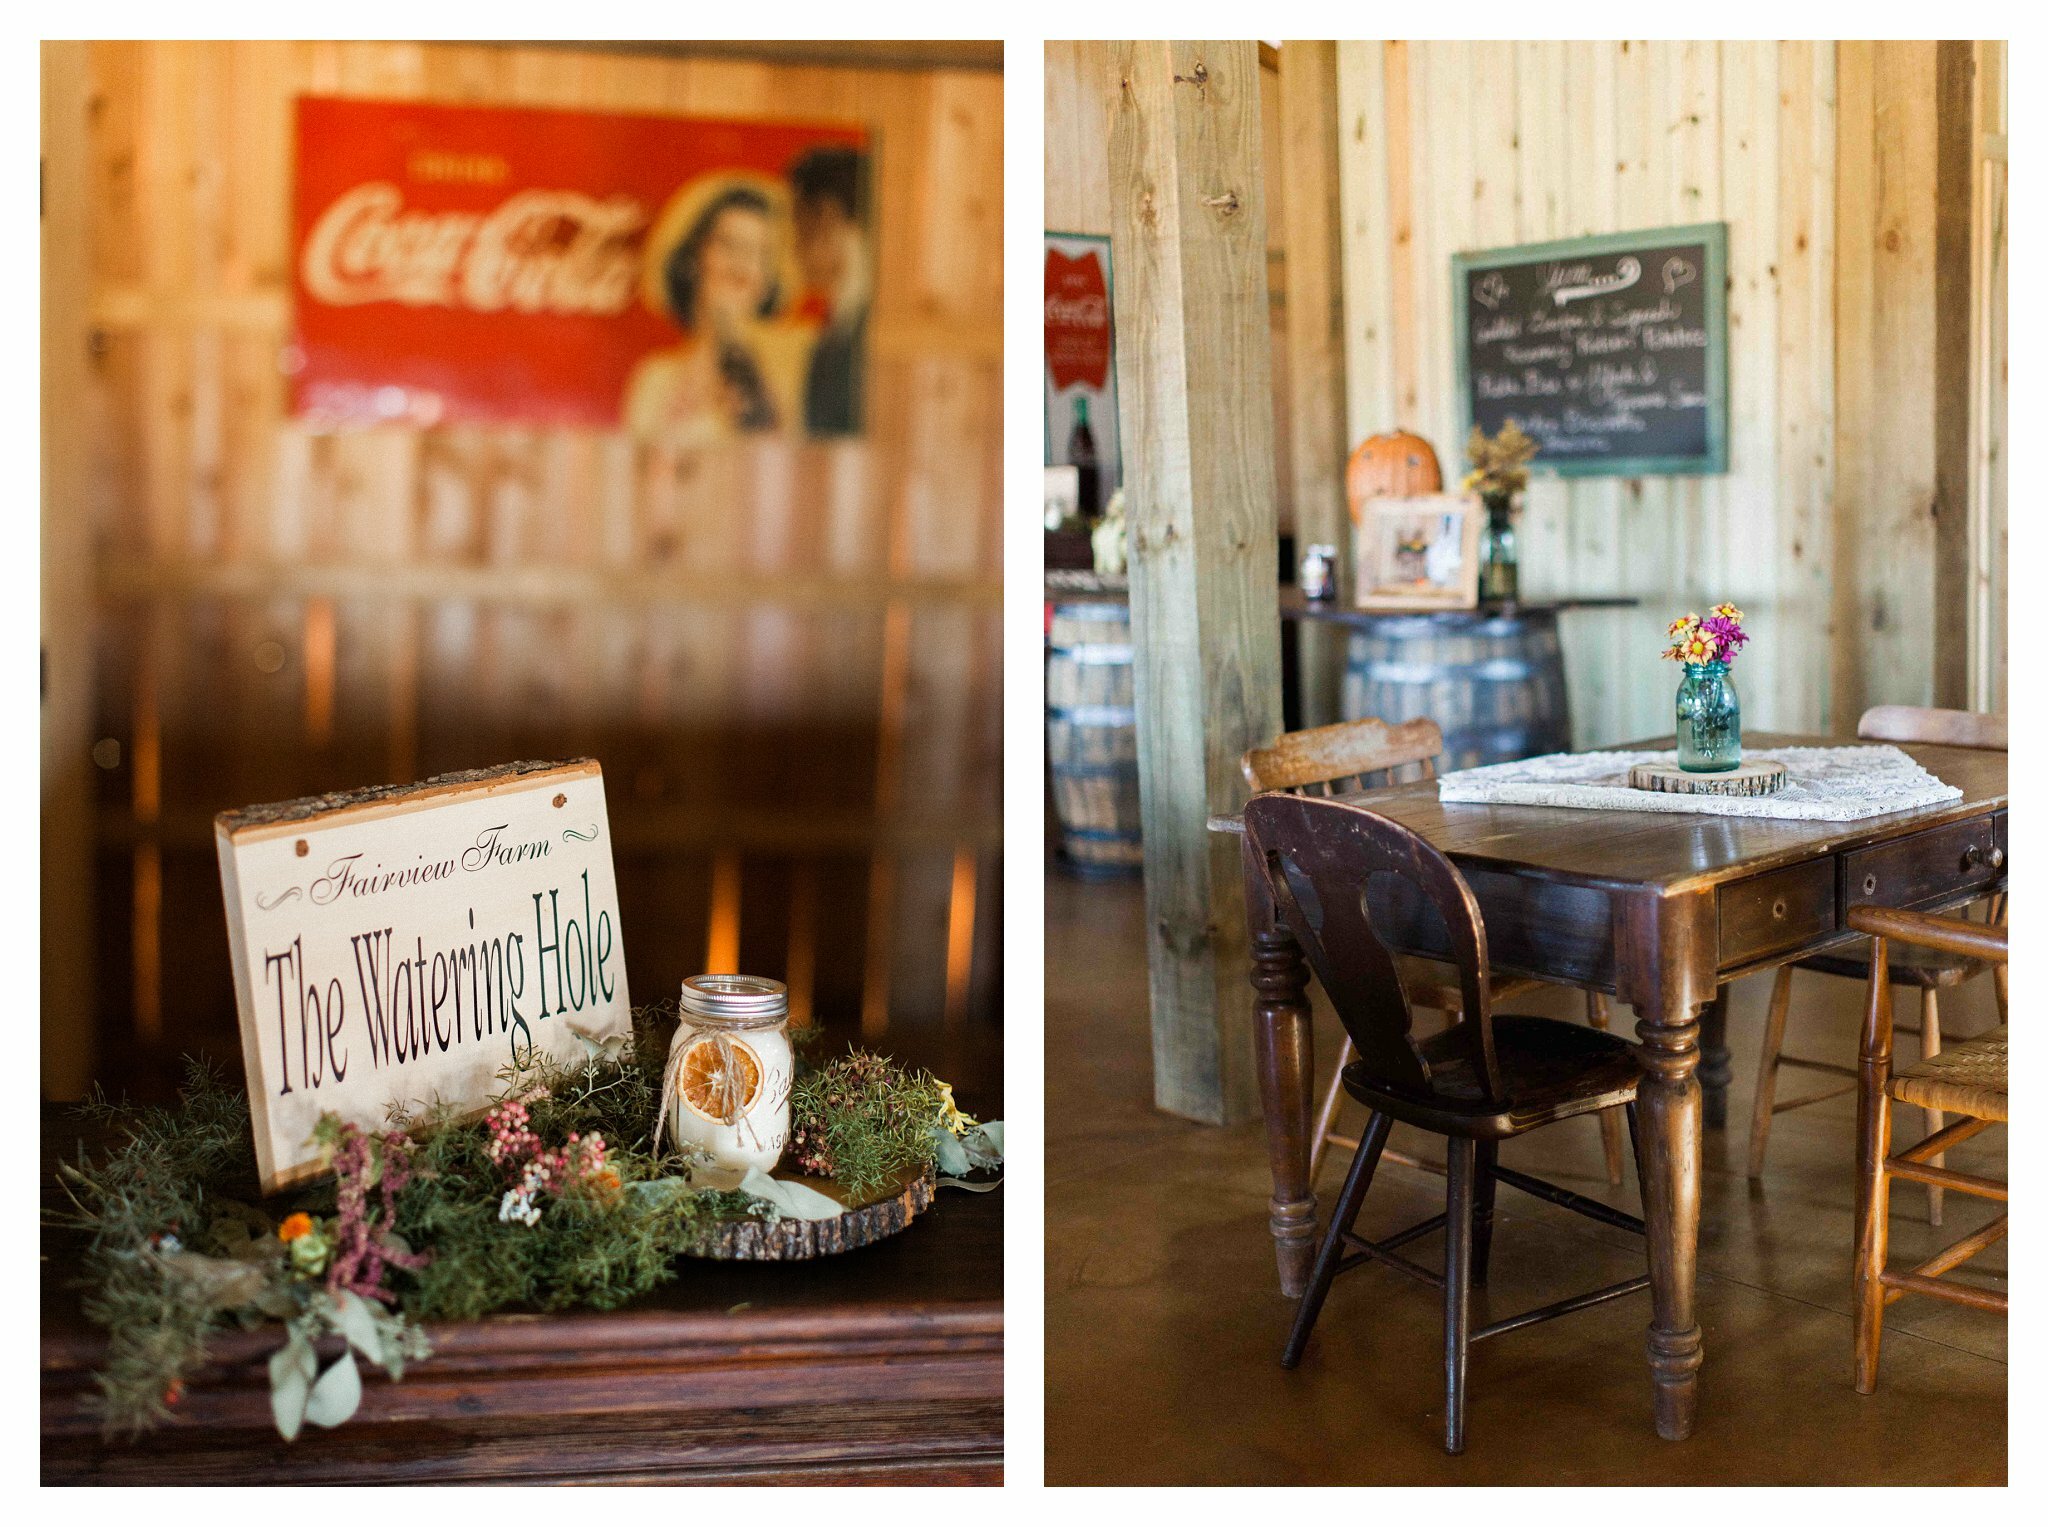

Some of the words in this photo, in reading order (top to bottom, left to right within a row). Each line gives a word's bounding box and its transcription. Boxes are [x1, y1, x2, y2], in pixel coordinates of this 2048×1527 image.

[309, 853, 457, 906] Fairview
[461, 823, 553, 873] Farm
[265, 933, 349, 1097] The
[350, 907, 534, 1073] Watering
[531, 868, 615, 1021] Hole
